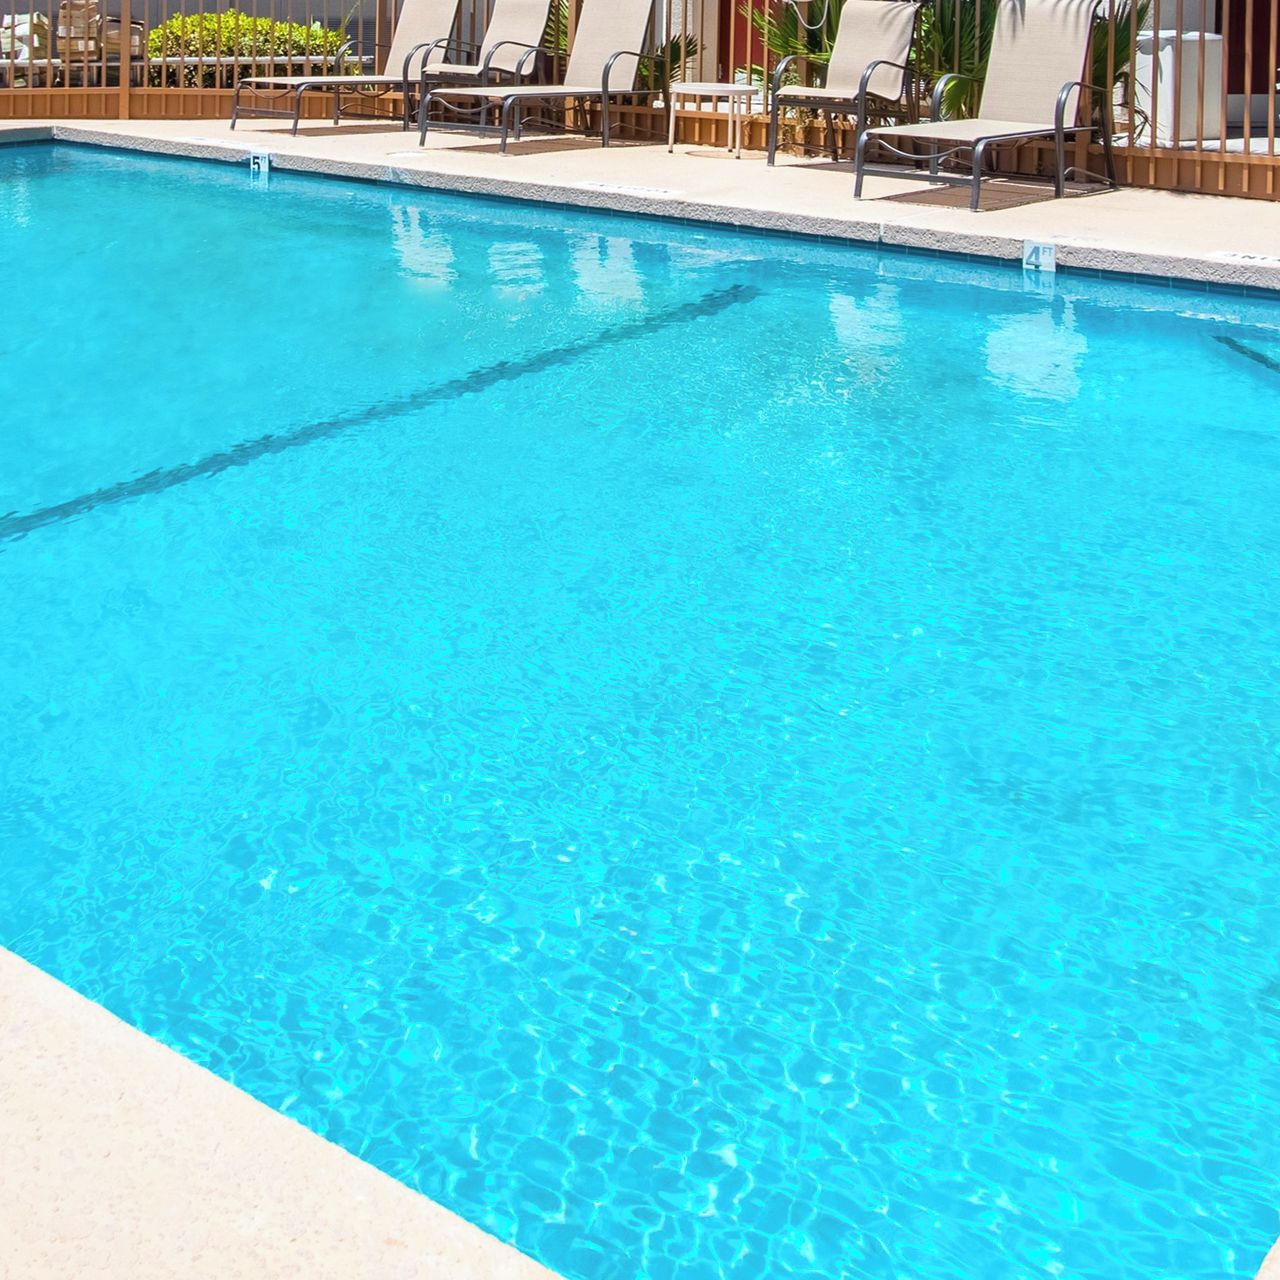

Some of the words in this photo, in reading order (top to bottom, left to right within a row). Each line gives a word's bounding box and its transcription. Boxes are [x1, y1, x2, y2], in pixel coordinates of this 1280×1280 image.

[252, 155, 261, 171] 5
[1026, 246, 1042, 269] 4
[1041, 247, 1054, 257] FT
